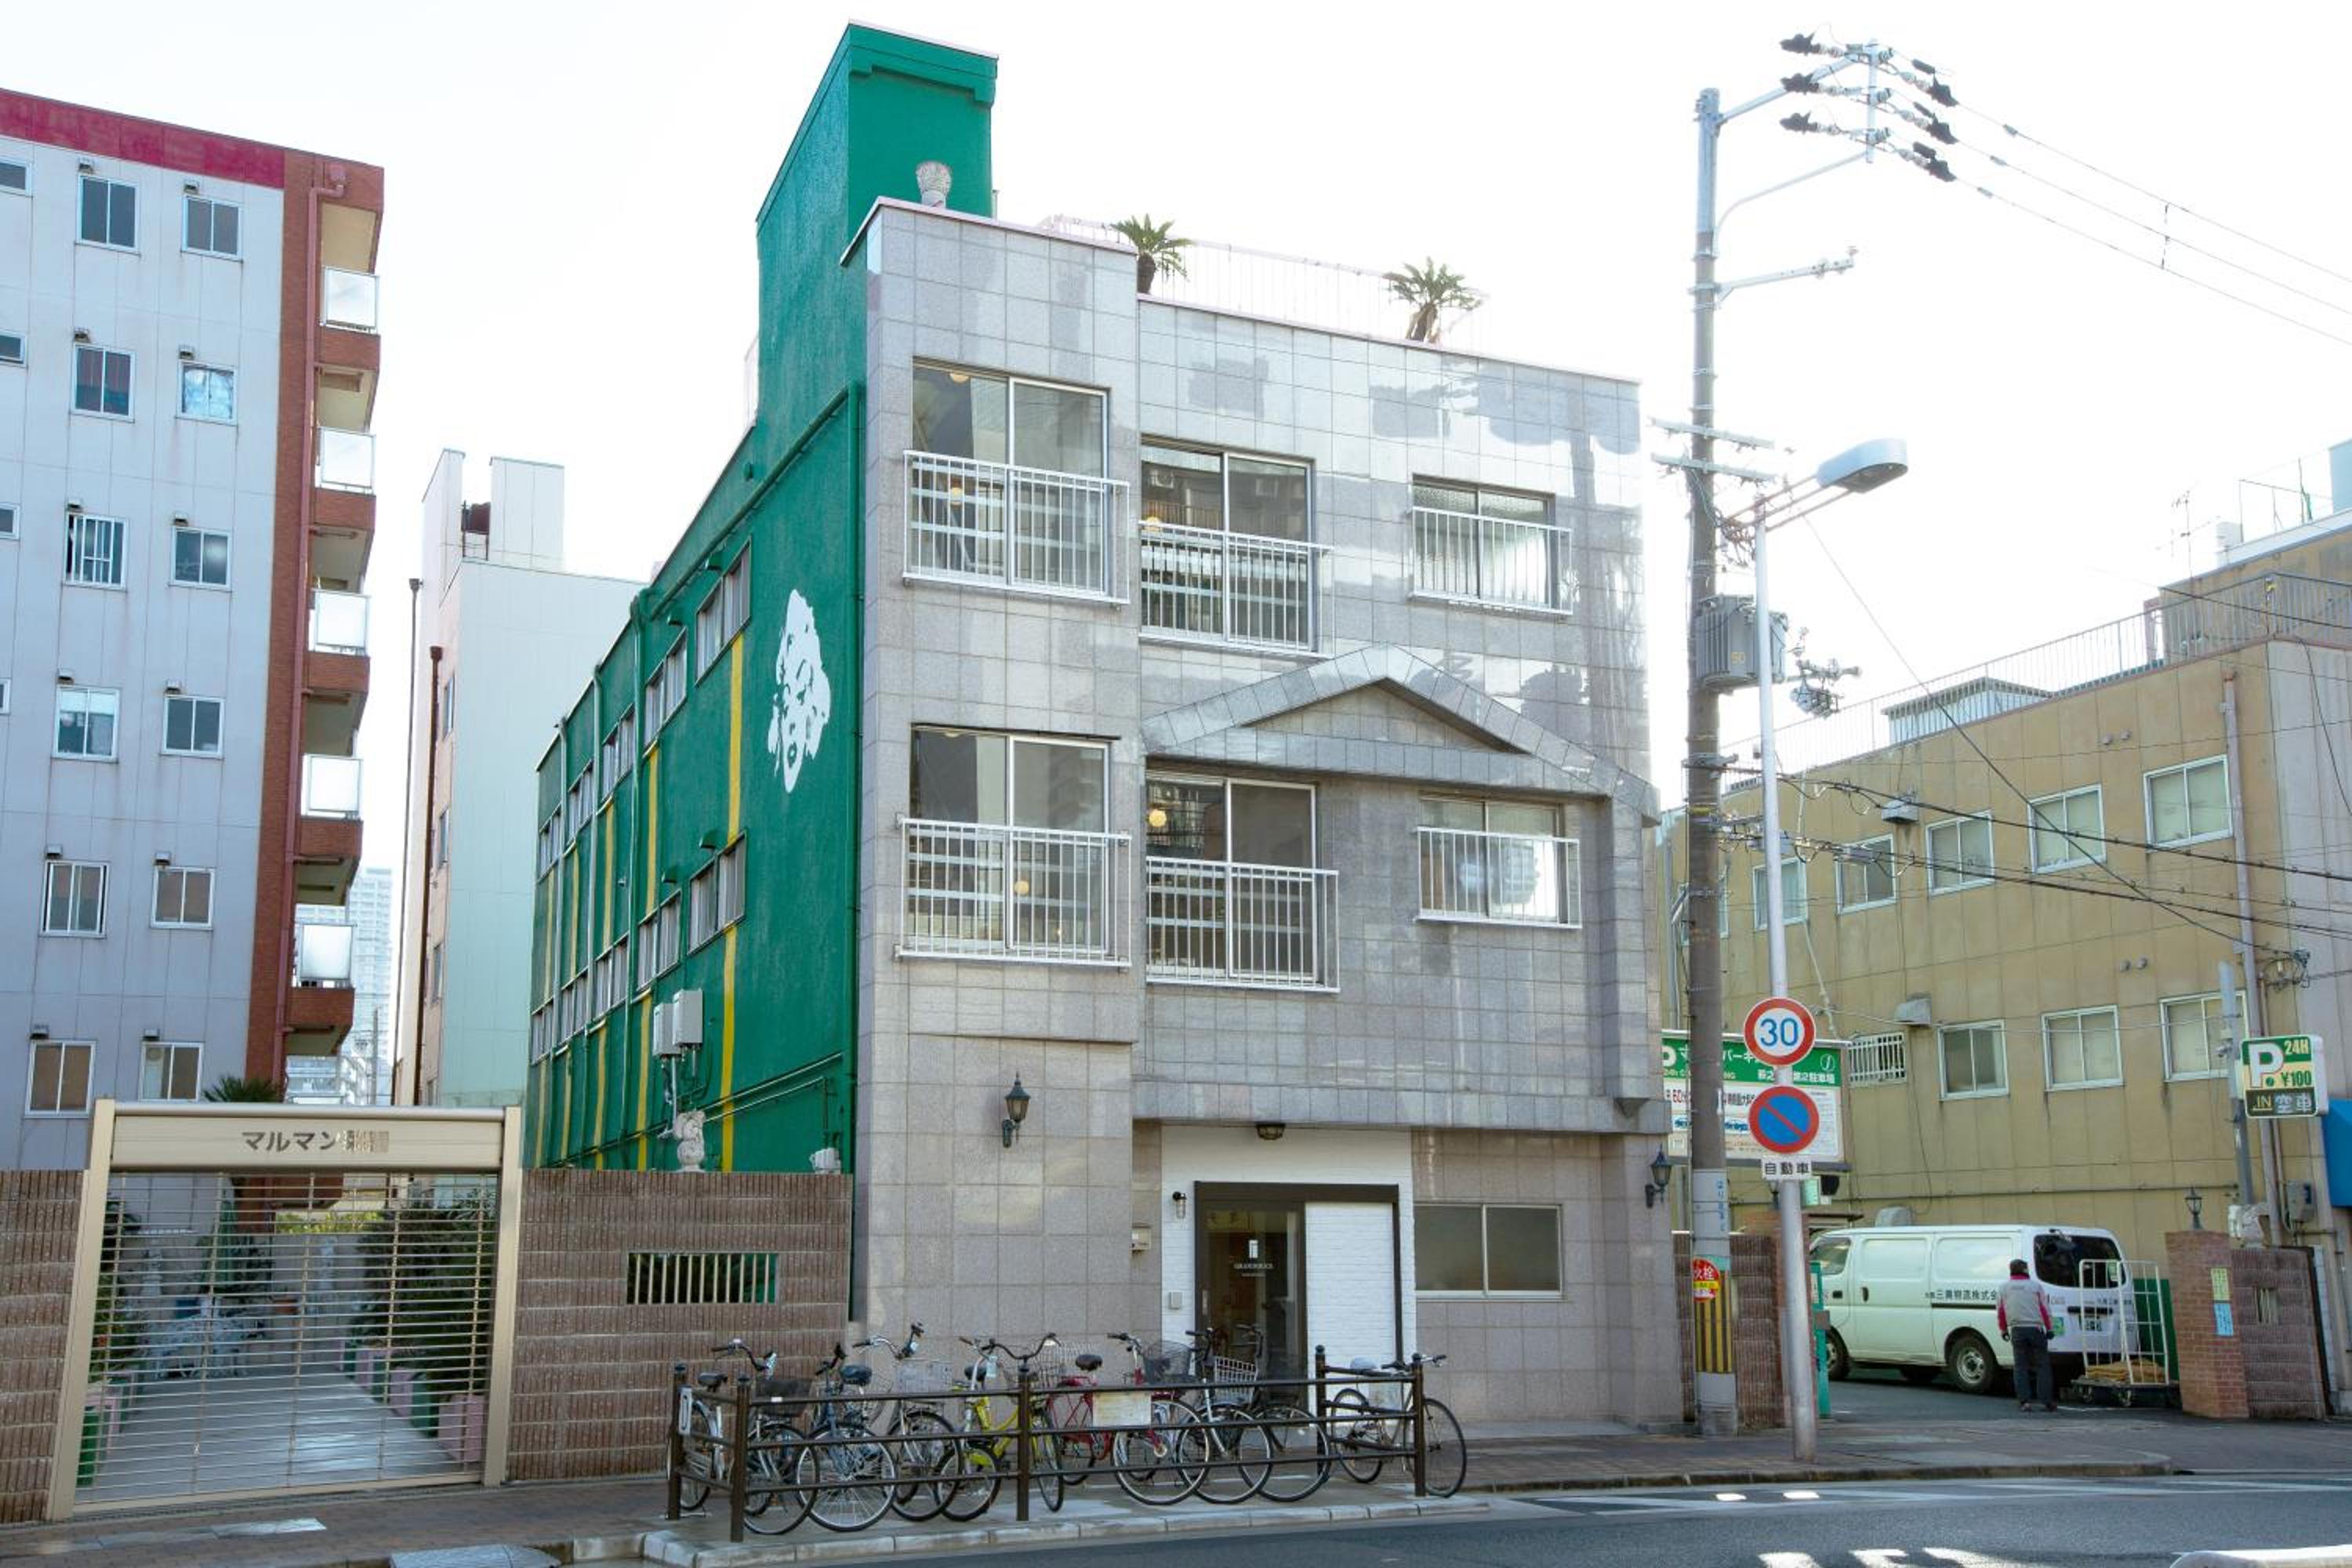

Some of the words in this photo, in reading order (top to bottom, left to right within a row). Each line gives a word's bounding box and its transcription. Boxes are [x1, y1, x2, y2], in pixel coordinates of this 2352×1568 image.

[1759, 1018, 1798, 1047] 30
[2284, 1039, 2309, 1054] 24H
[2249, 1042, 2284, 1088] P
[241, 1131, 389, 1153] マルマン
[1765, 1161, 1809, 1175] 自動車
